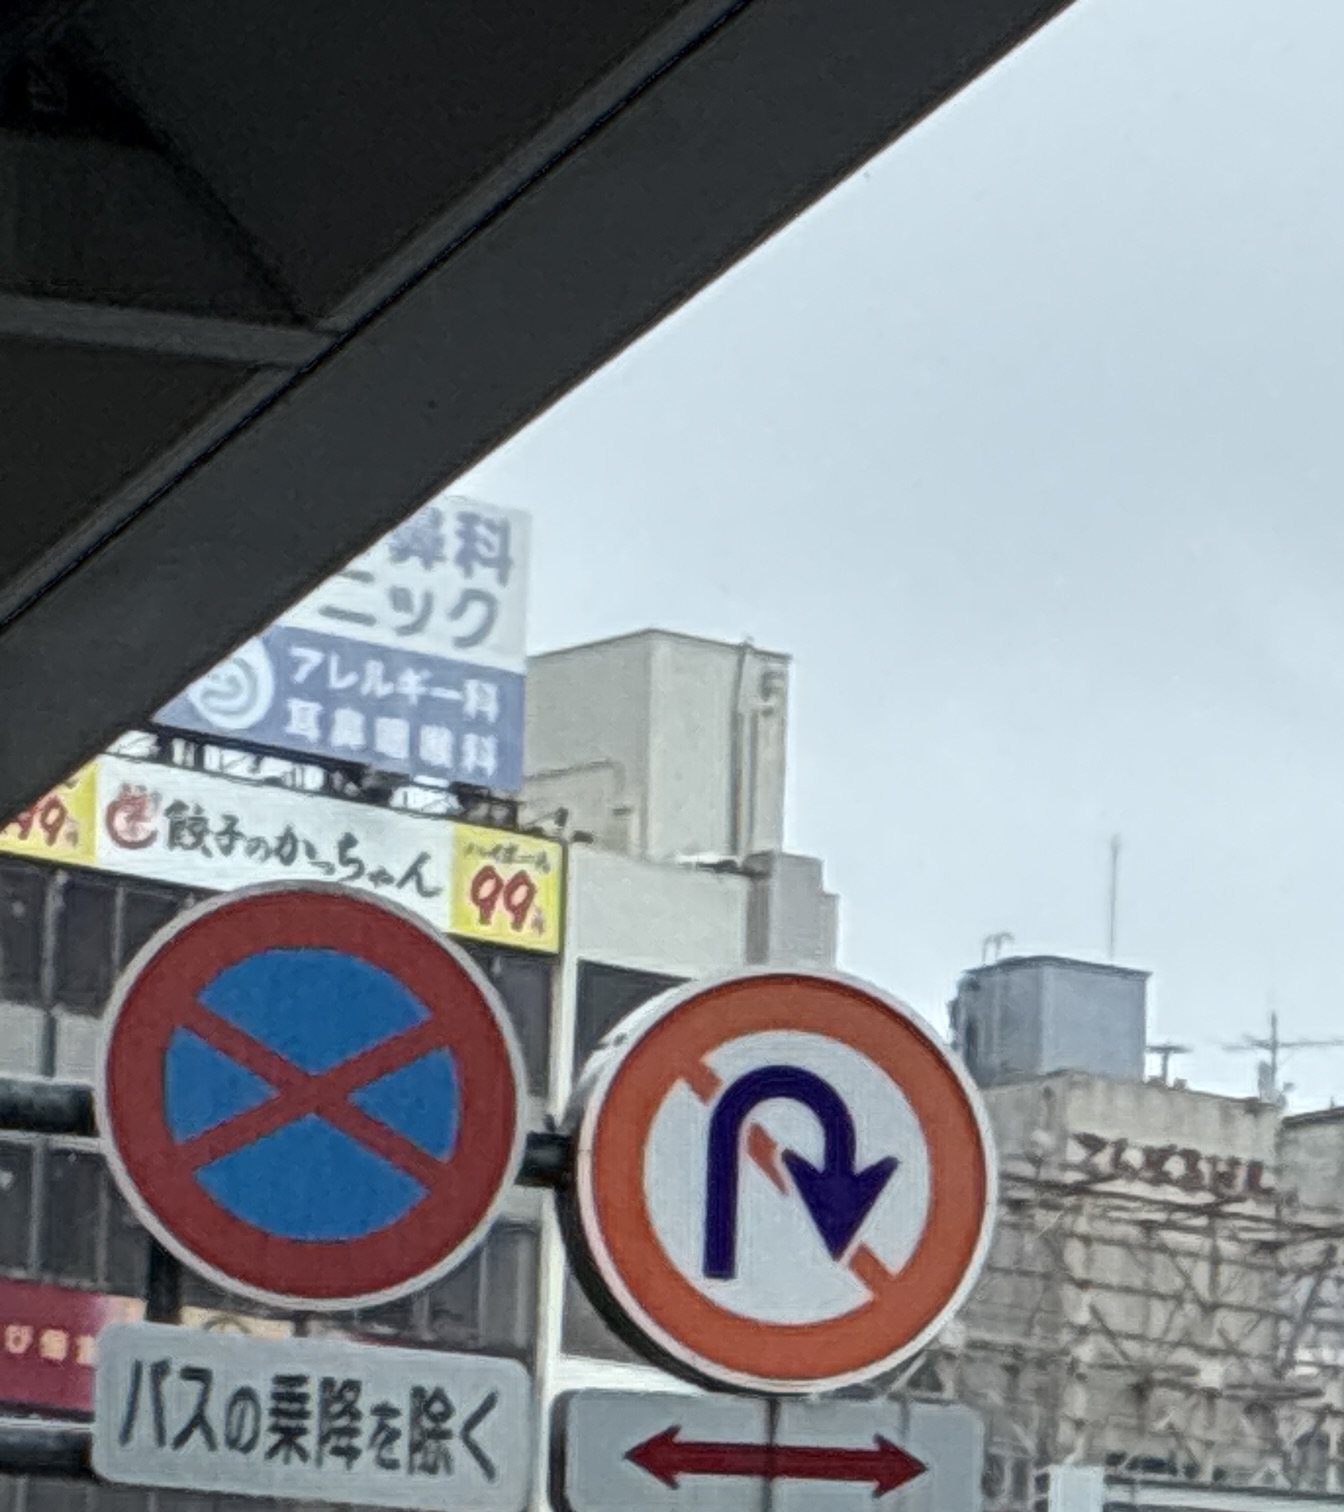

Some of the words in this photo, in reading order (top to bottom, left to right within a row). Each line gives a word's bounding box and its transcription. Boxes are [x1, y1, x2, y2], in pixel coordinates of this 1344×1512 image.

[289, 646, 500, 724] アレルギー科
[118, 1357, 501, 1483] バスの乗降を除く
